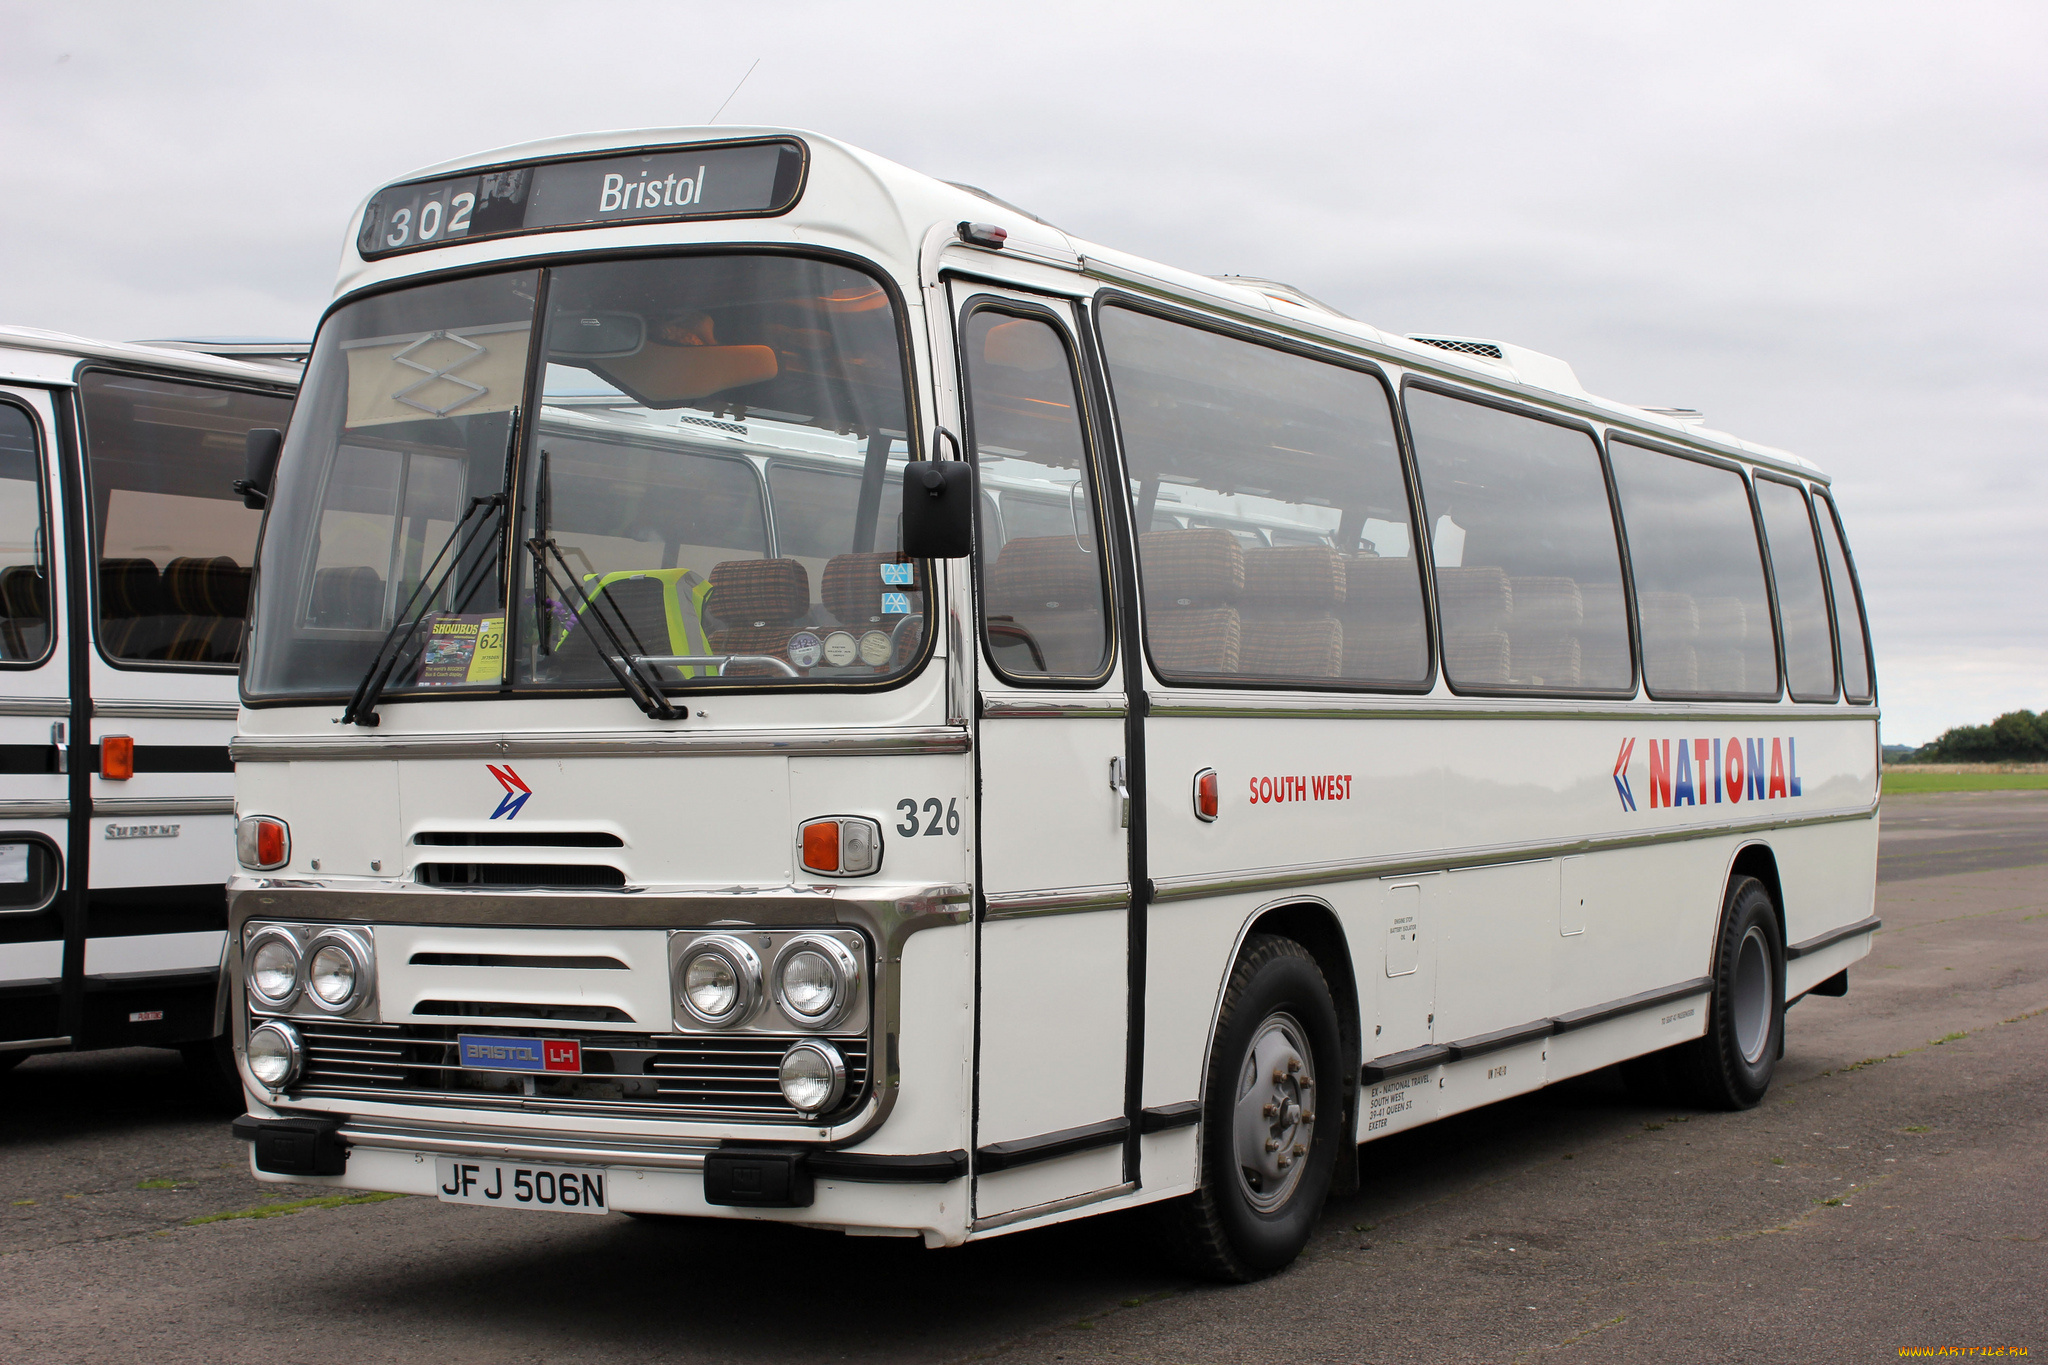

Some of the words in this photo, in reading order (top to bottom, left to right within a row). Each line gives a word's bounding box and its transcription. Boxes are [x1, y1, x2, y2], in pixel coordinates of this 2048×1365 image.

[599, 165, 706, 213] Bristol
[386, 192, 476, 247] 302
[432, 623, 479, 635] SHOWBUS
[1650, 737, 1802, 809] NATIONAL
[1250, 777, 1307, 804] SOUTH
[1311, 775, 1353, 802] WEST
[896, 797, 960, 838] 326
[466, 1044, 539, 1062] BRISTOL
[549, 1048, 574, 1063] LH
[1371, 1088, 1379, 1097] EX
[1383, 1079, 1411, 1094] NATIONAL
[1369, 1108, 1385, 1120] 39-41
[1386, 1102, 1406, 1115] QUEEN
[1370, 1095, 1390, 1109] SOUTH
[1368, 1118, 1388, 1131] EXETER
[442, 1163, 502, 1200] JFJ
[514, 1169, 605, 1208] 506N
